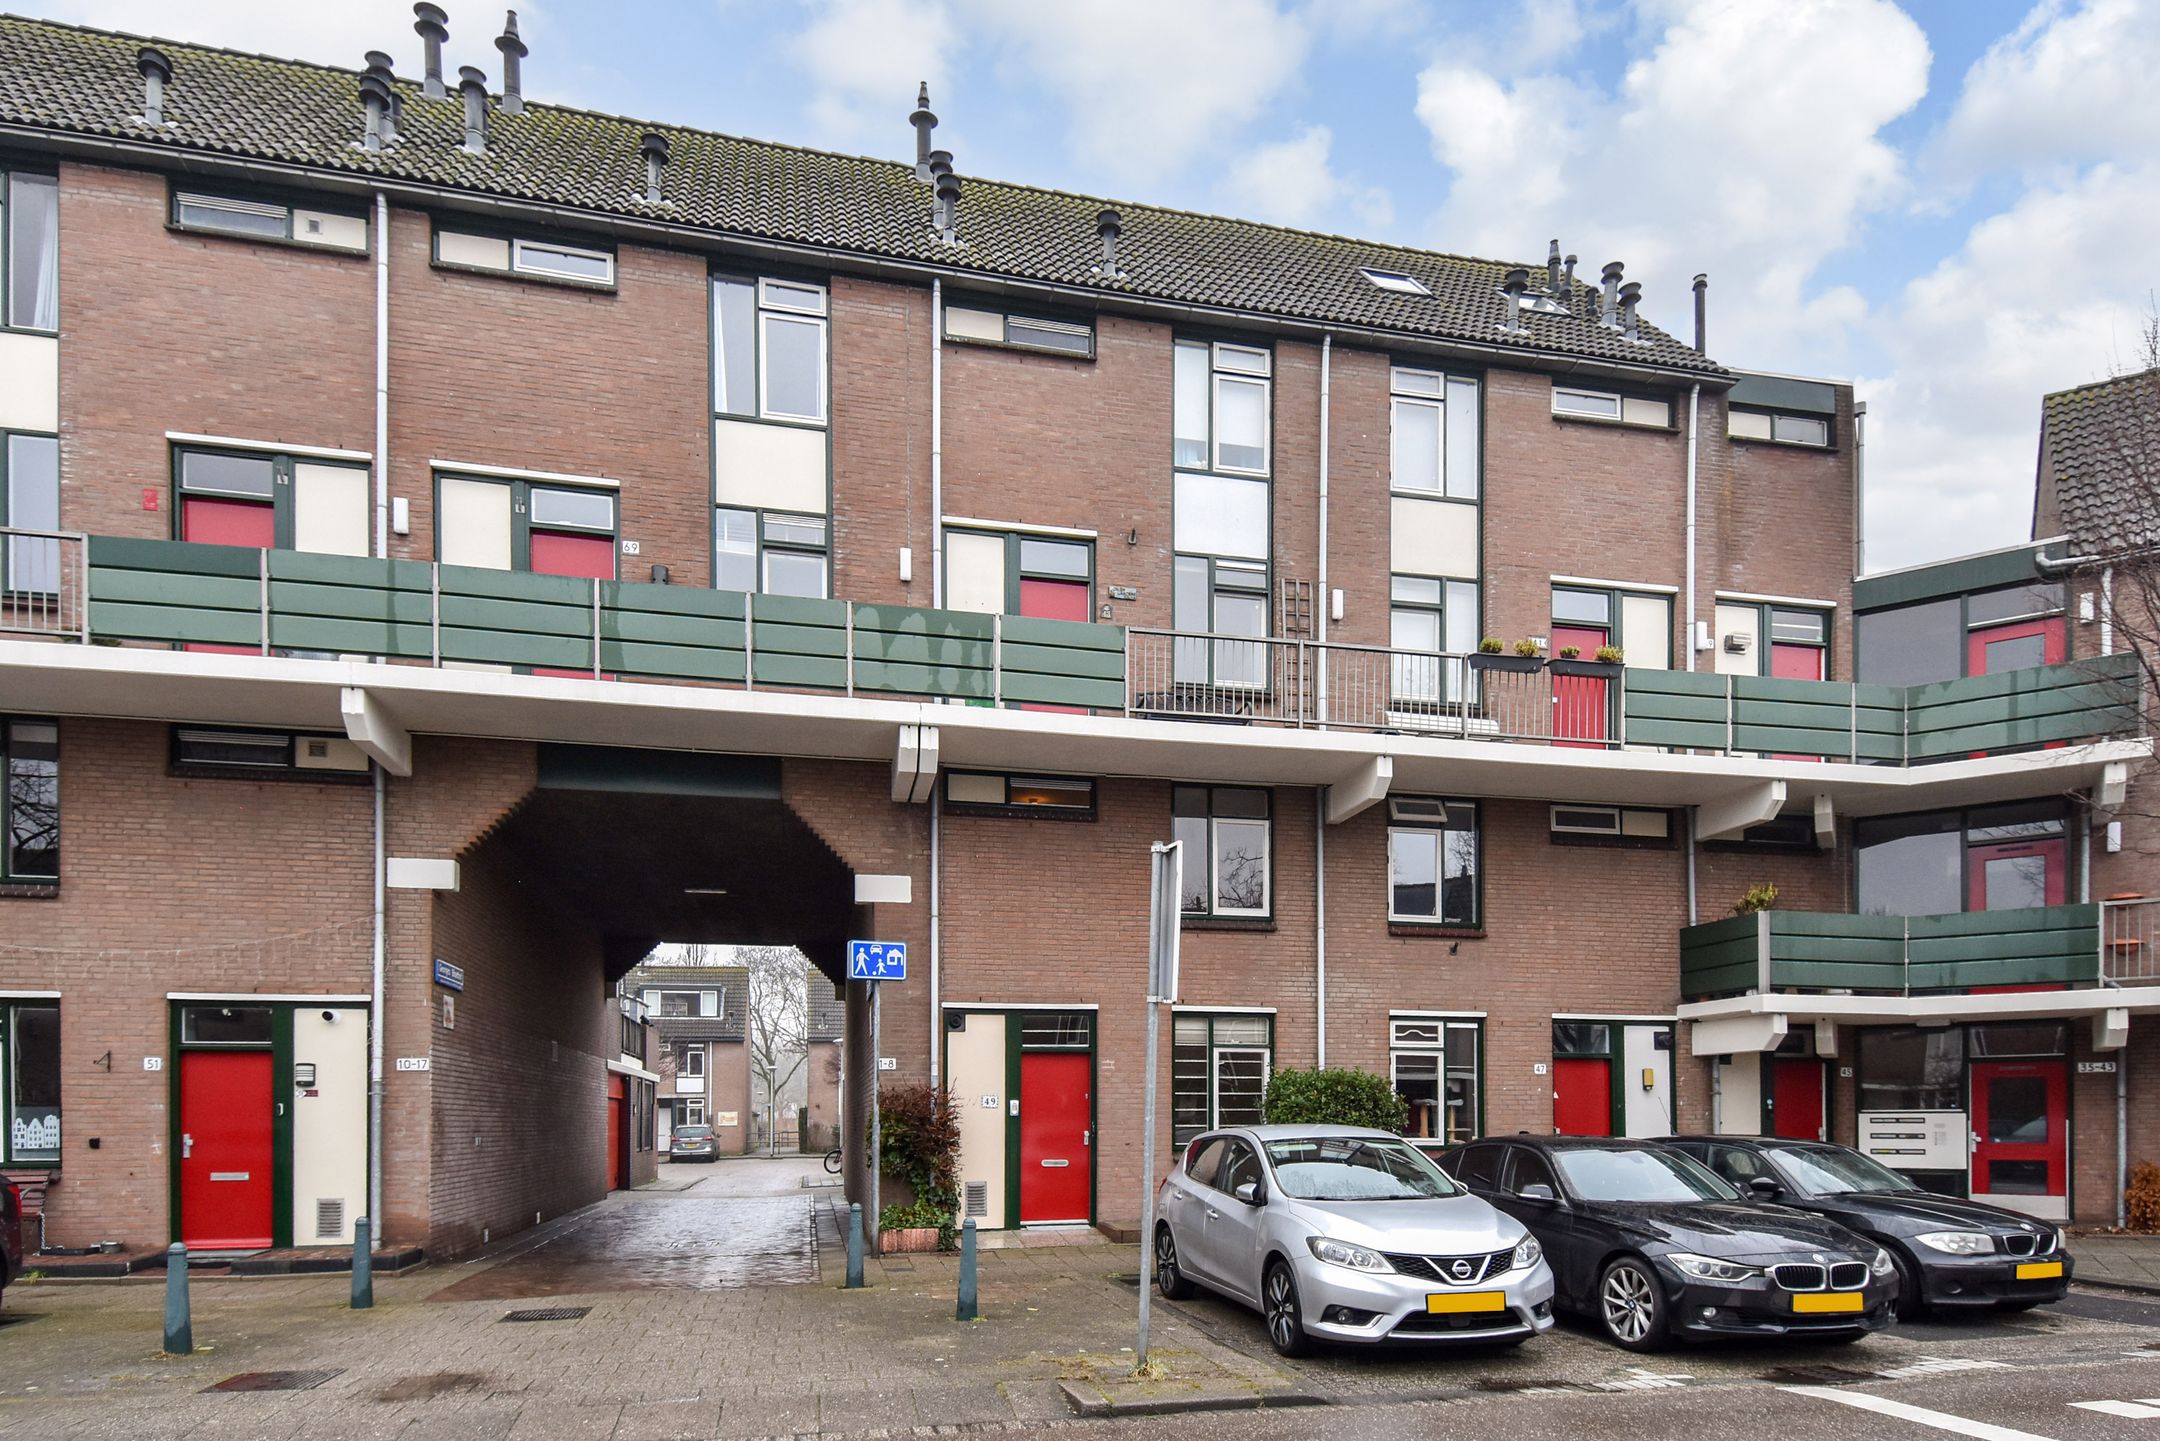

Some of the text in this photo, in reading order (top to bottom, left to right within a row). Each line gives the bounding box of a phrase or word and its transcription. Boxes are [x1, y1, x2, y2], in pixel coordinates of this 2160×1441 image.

[624, 542, 637, 552] 69
[147, 1059, 158, 1069] 51
[399, 1060, 427, 1069] 10-17
[880, 1060, 893, 1068] 1-8
